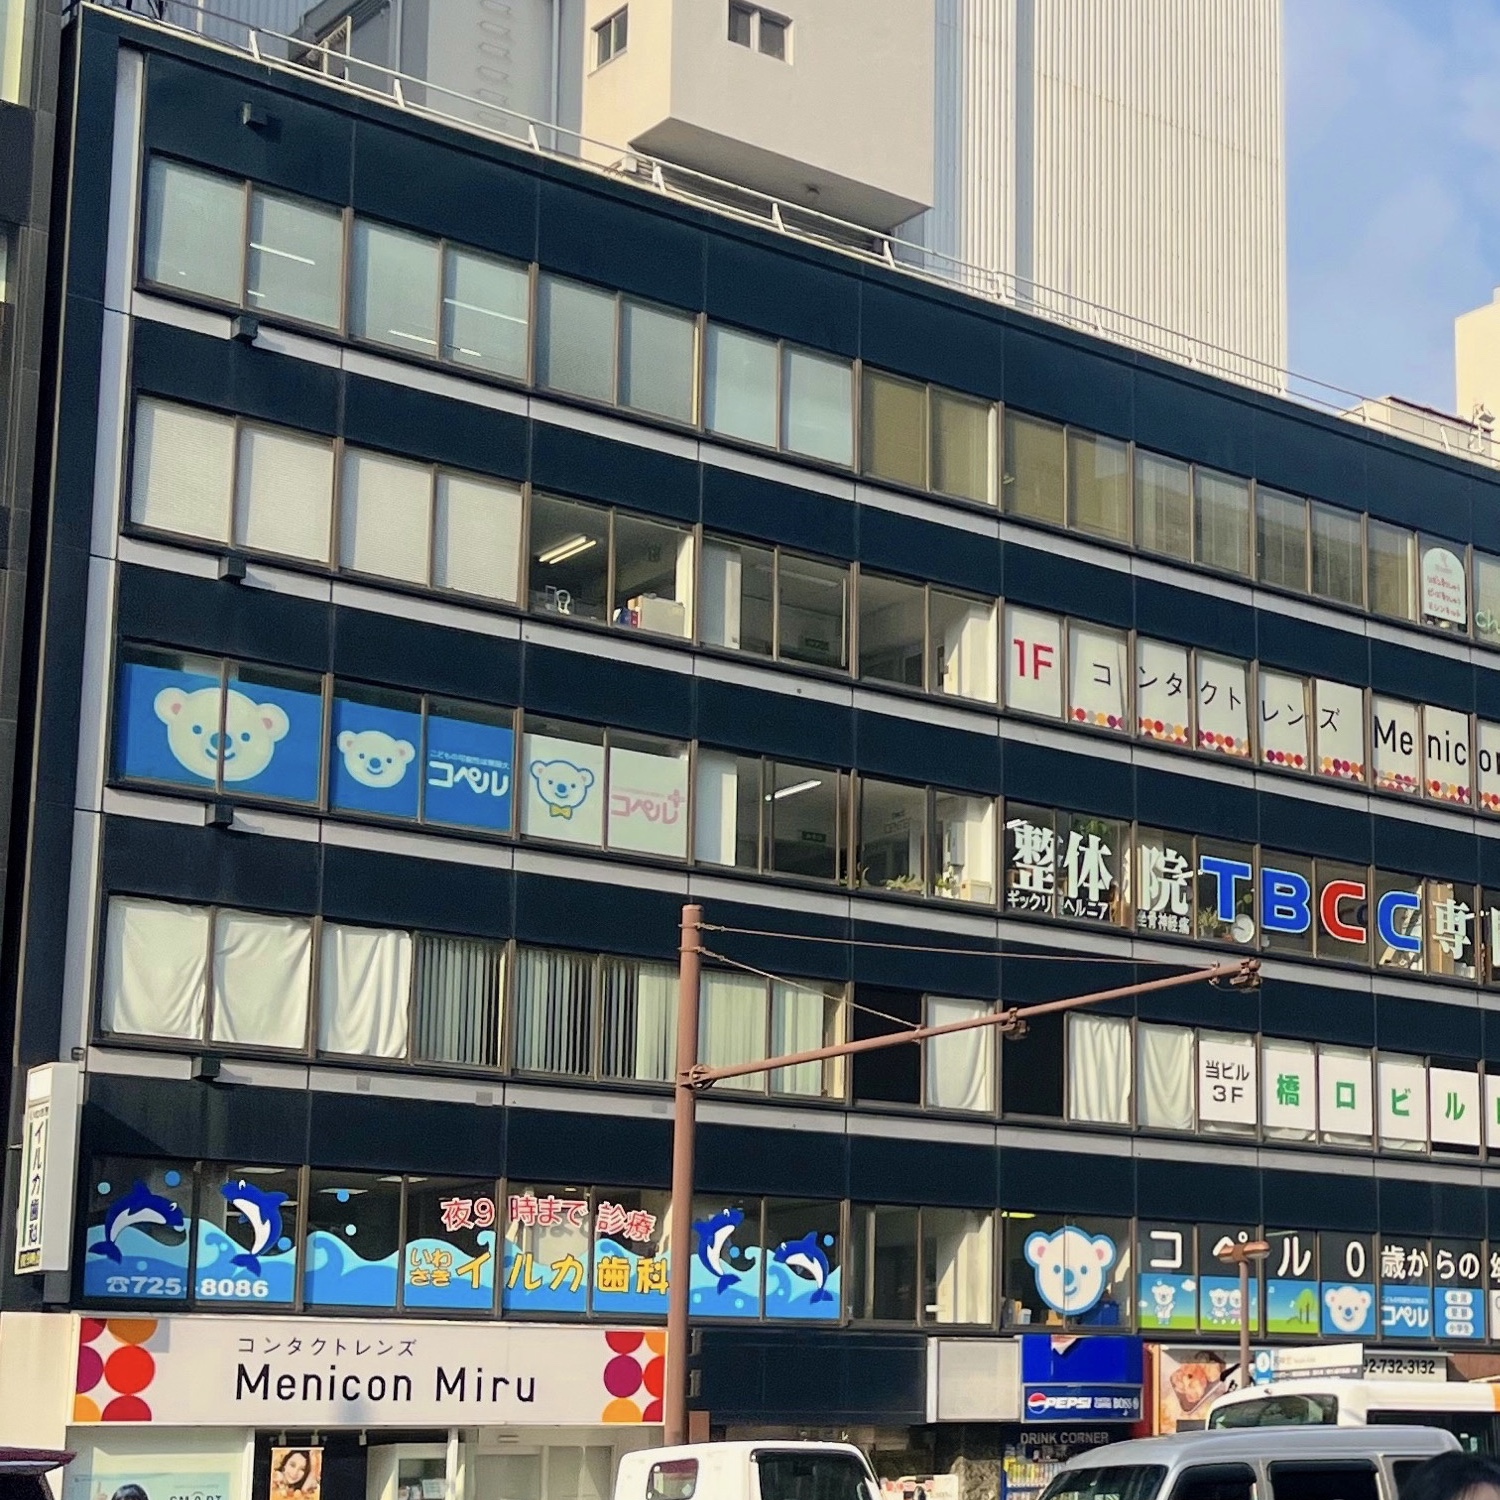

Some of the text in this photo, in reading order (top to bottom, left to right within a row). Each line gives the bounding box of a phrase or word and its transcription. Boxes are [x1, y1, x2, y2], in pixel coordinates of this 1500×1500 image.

[1013, 638, 1054, 680] 1F
[1093, 662, 1341, 732] コンタクトレンズ
[428, 760, 509, 797] コペル
[1012, 823, 1193, 916] 整体院
[1063, 896, 1109, 920] ヘルニア
[1200, 854, 1422, 954] TBCC
[1205, 1060, 1250, 1082] 当ビル
[1212, 1085, 1244, 1104] 3F
[440, 1195, 657, 1243] 夜9時まで診療
[455, 1251, 670, 1295] イルカ歯科
[1381, 1305, 1429, 1328] コペル
[238, 1337, 417, 1357] コンタクトレンズ
[236, 1363, 536, 1402] Menicon Miru
[1046, 1396, 1093, 1410] PEPSI
[1020, 1431, 1110, 1444] DRINK CORNER
